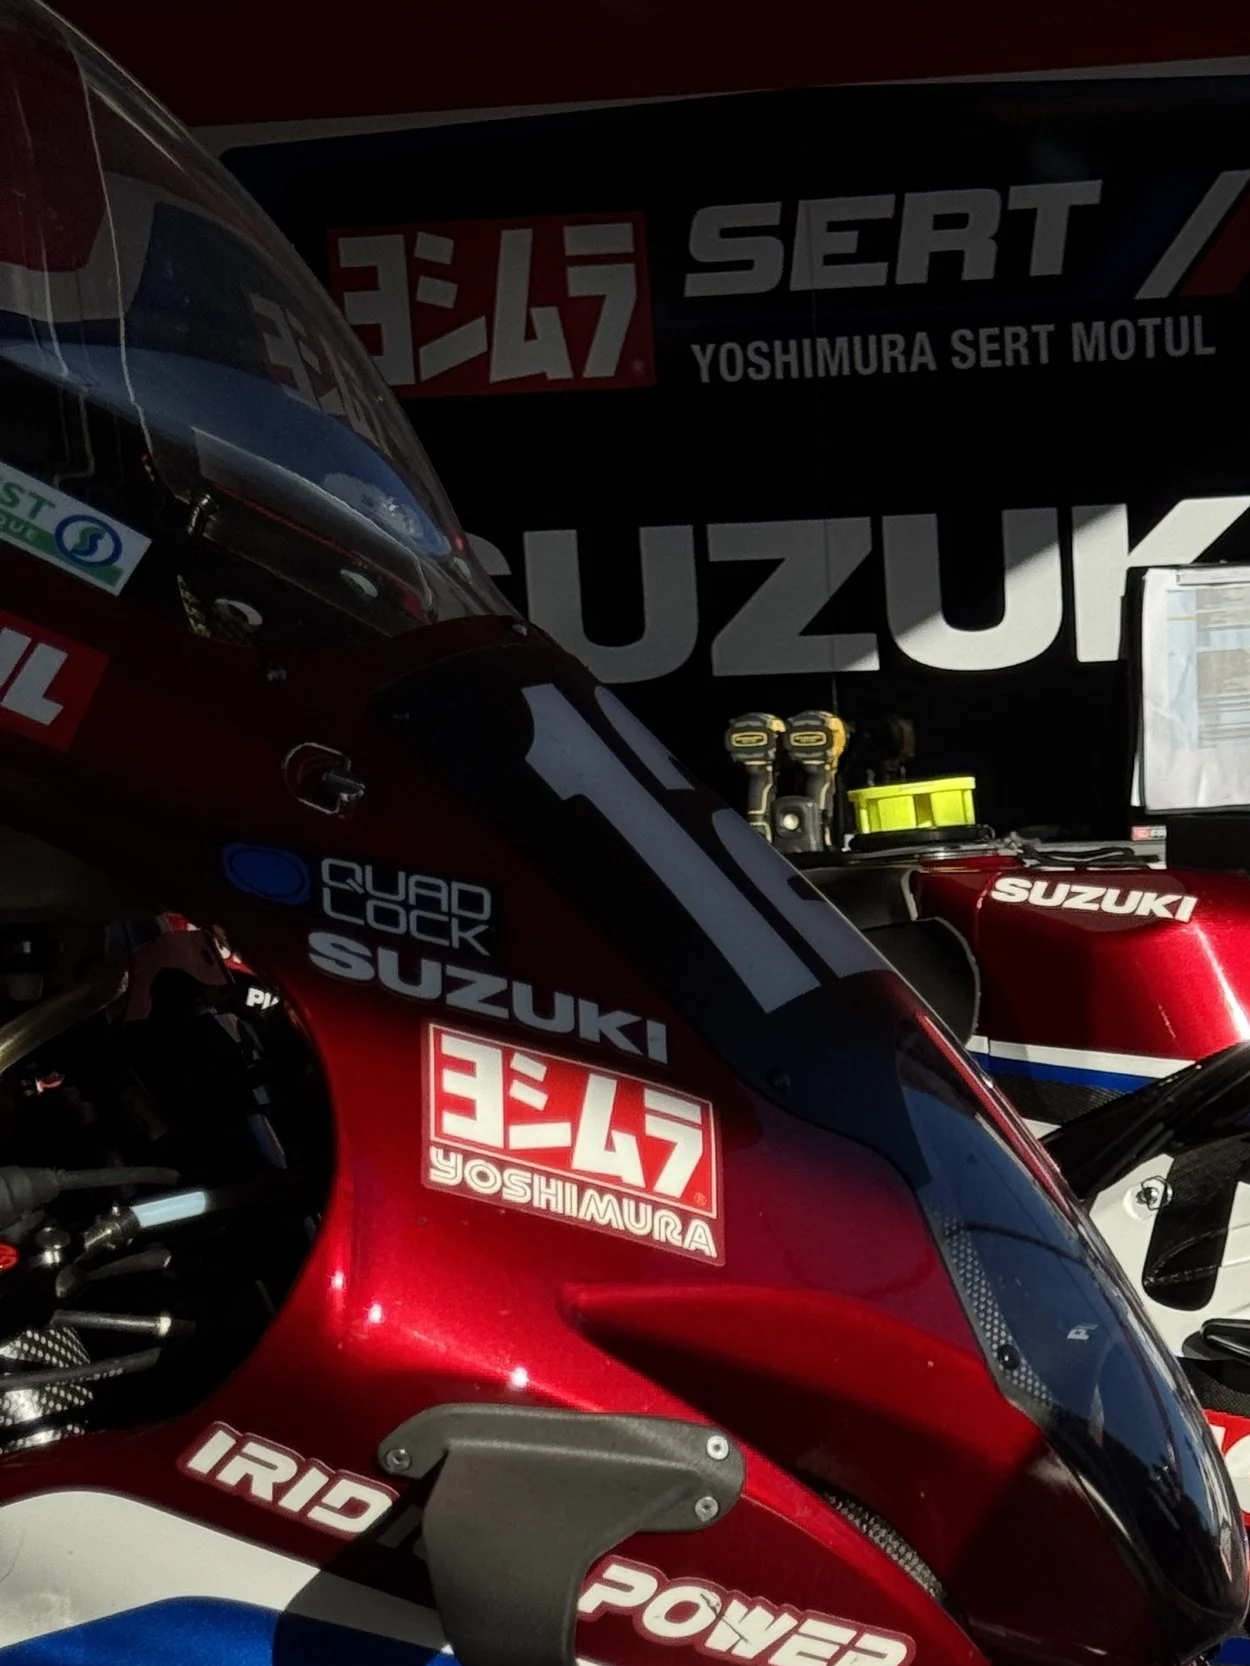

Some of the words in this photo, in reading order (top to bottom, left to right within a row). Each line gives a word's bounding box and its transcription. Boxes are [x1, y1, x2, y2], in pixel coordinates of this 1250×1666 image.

[684, 178, 1103, 298] SERT
[691, 330, 937, 384] YOSHIMURA
[950, 323, 1056, 370] SERT
[1071, 314, 1217, 363] MOTUL
[320, 857, 492, 918] QUAD
[321, 886, 491, 957] LOCK
[990, 876, 1199, 923] SUZUKI
[307, 930, 669, 1065] SUZUKI
[440, 1033, 703, 1200] ヨシムラ
[429, 1145, 718, 1259] YOSHIMURA
